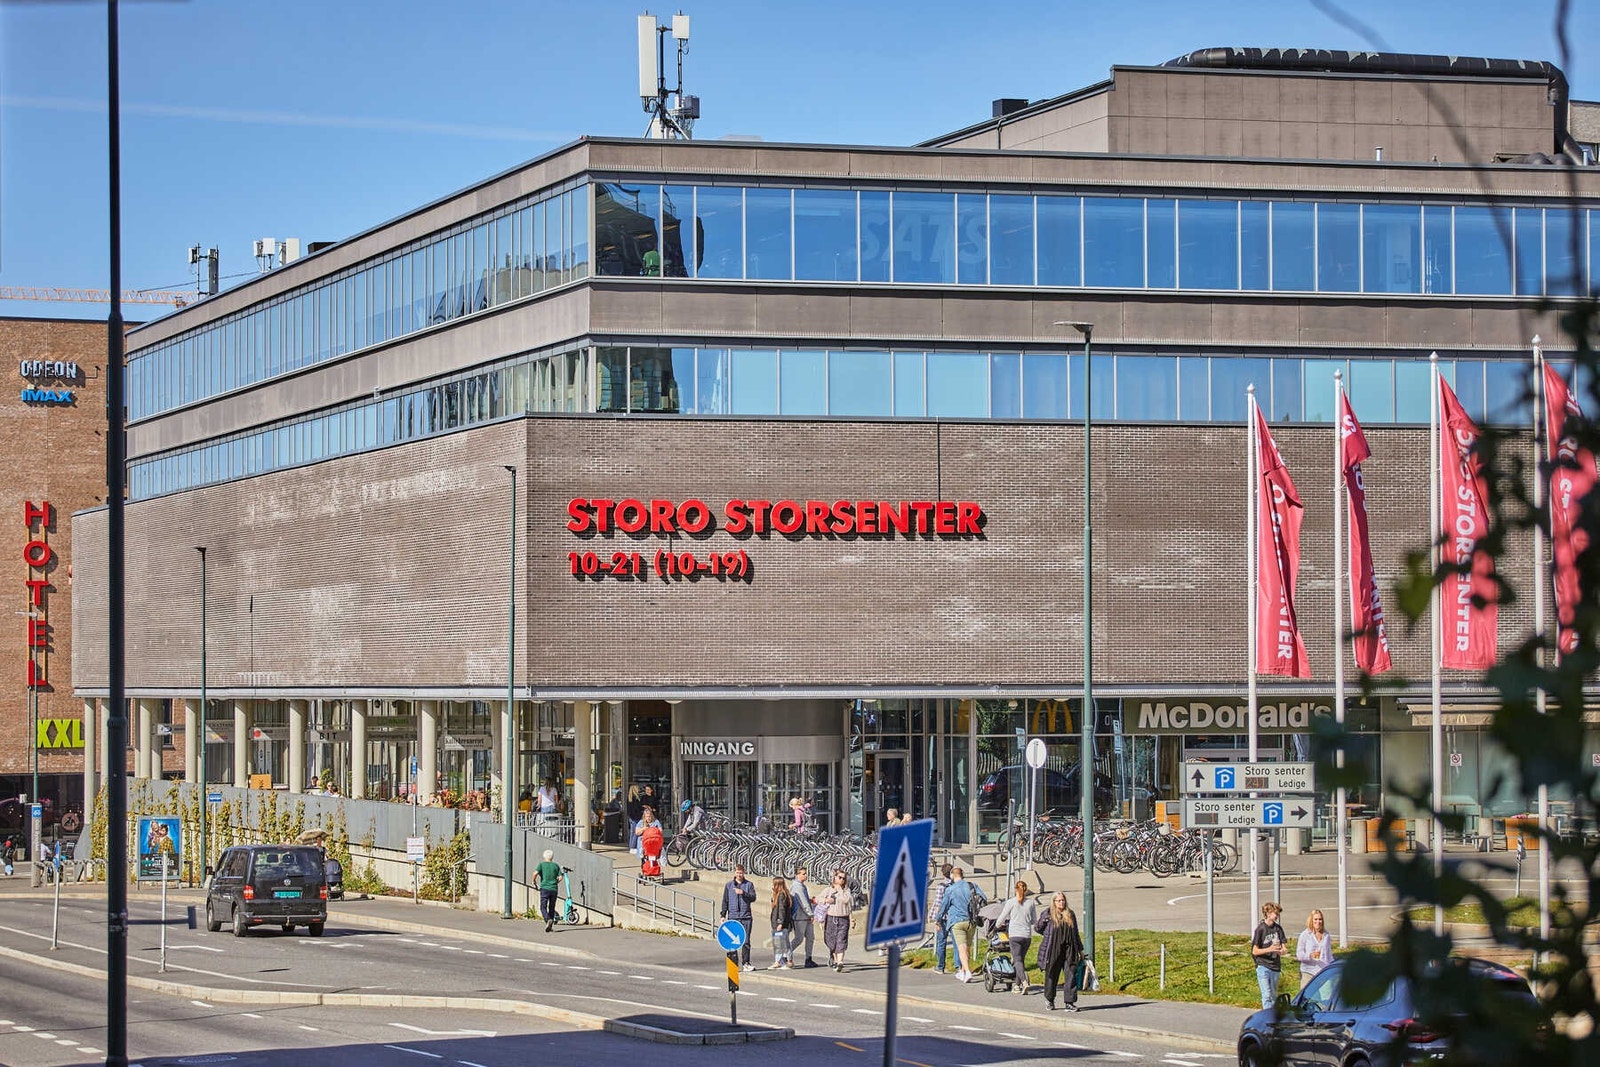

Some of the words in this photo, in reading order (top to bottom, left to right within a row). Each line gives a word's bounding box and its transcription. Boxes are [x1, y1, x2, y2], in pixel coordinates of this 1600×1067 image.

[20, 359, 77, 379] ODEON
[21, 390, 73, 403] IMAX
[566, 498, 710, 534] STORO
[723, 499, 984, 534] STORSENTER
[567, 551, 642, 575] 10-21
[653, 550, 748, 577] (10-19)
[23, 500, 51, 687] HOTEL
[34, 718, 85, 749] XXL
[680, 741, 755, 756] INNGANG
[1245, 766, 1270, 776] Storo
[1275, 767, 1306, 776] senter
[1278, 779, 1306, 790] Ledige
[1194, 802, 1220, 812] Storo
[1224, 803, 1256, 812] senter
[1228, 815, 1256, 826] Ledige
